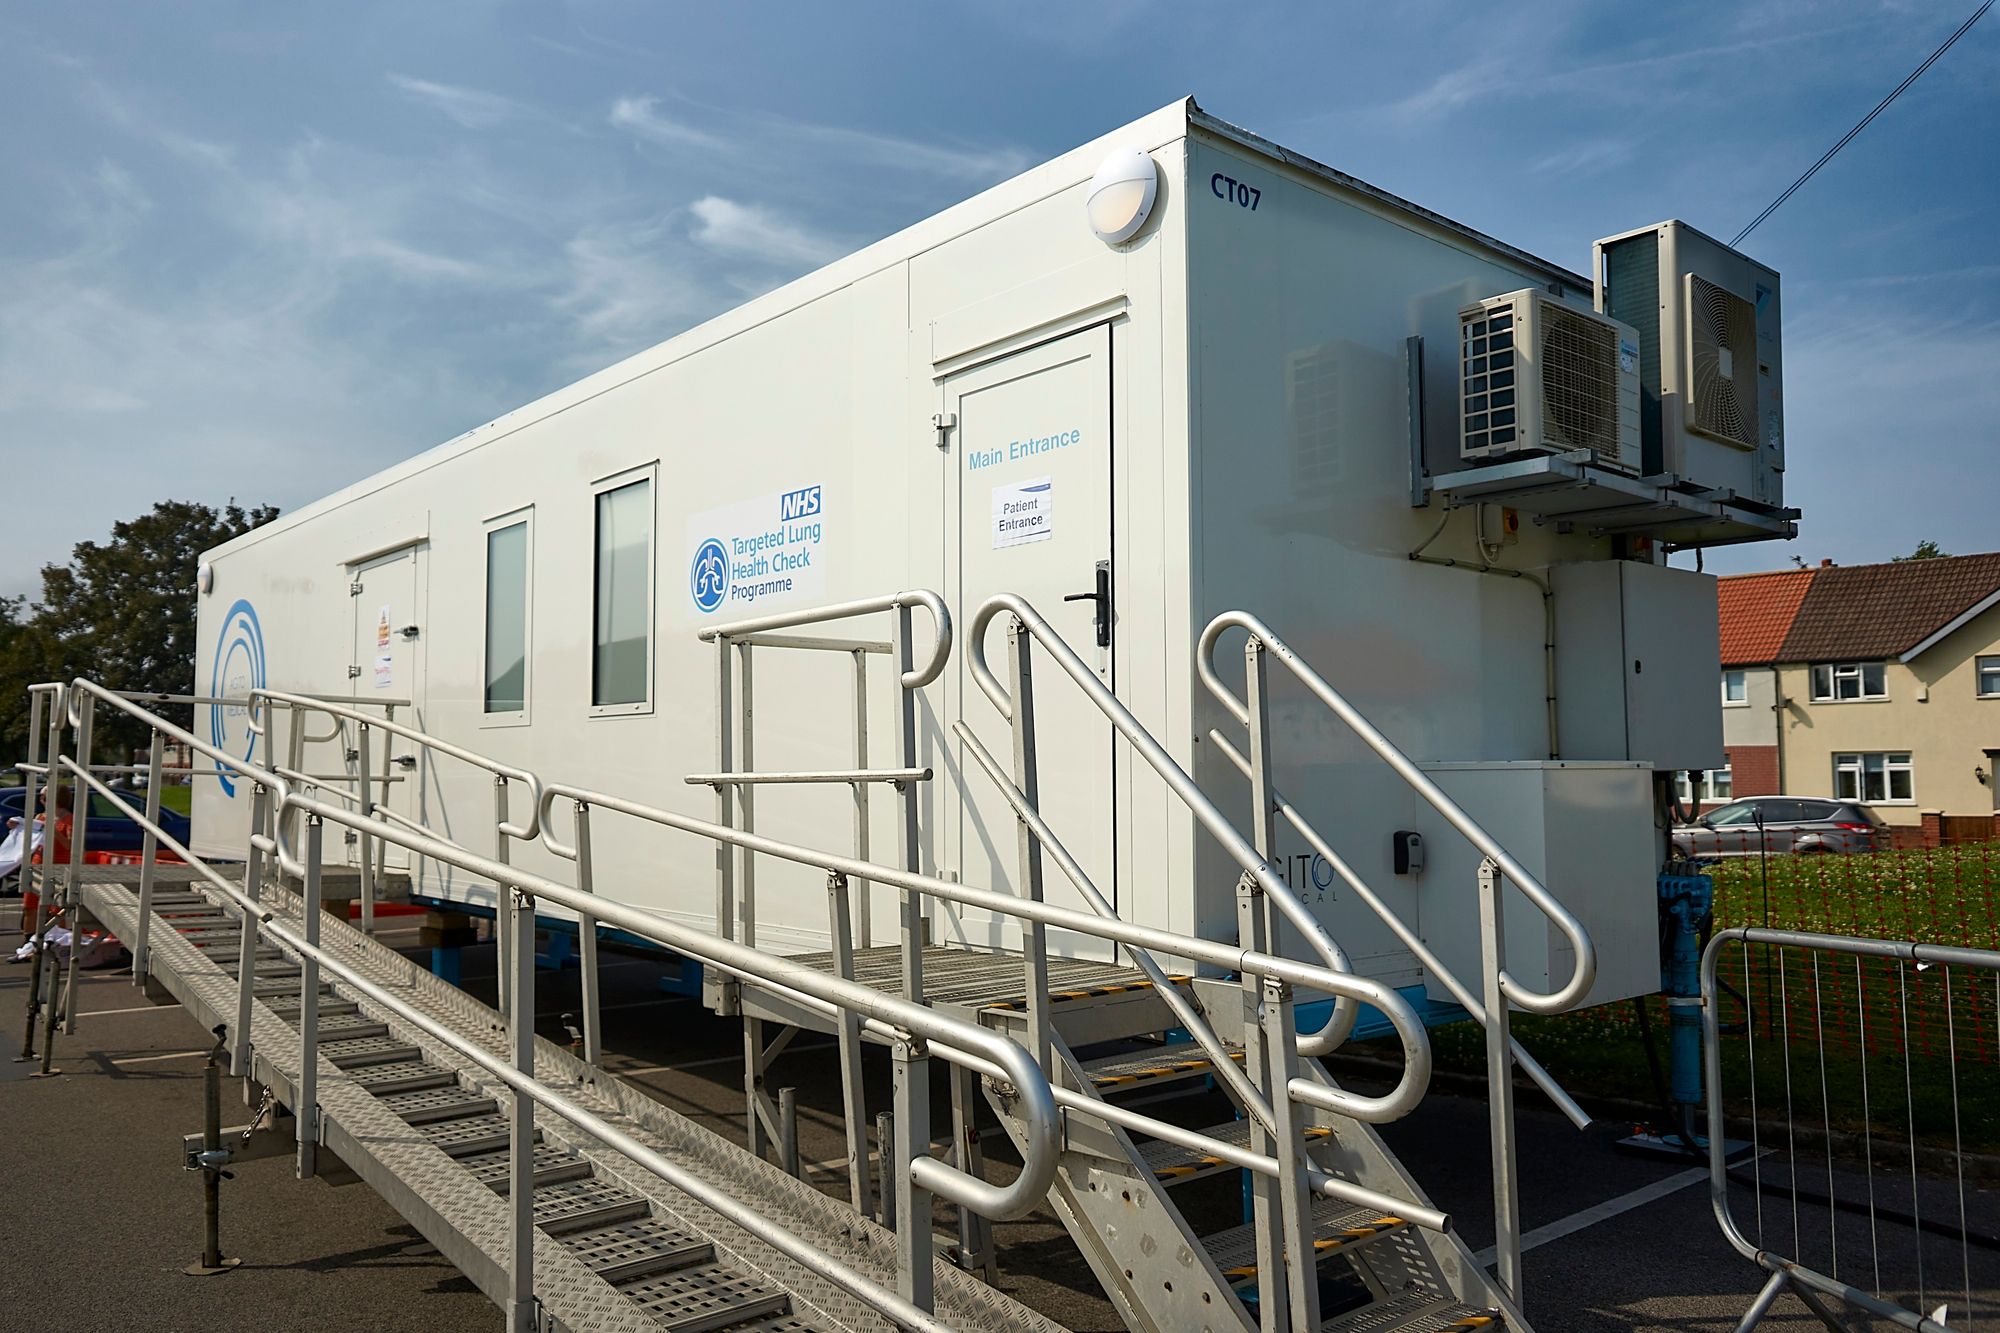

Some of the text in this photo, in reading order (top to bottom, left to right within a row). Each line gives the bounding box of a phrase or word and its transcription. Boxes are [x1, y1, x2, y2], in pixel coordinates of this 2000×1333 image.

[1211, 173, 1261, 211] CT07
[969, 429, 1080, 470] Main Entrance
[782, 487, 820, 520] NHS
[1003, 498, 1038, 515] Patient
[732, 522, 821, 557] Targeted Lung
[999, 515, 1043, 532] Entrance
[732, 547, 810, 580] Health Check
[731, 577, 792, 602] Programme
